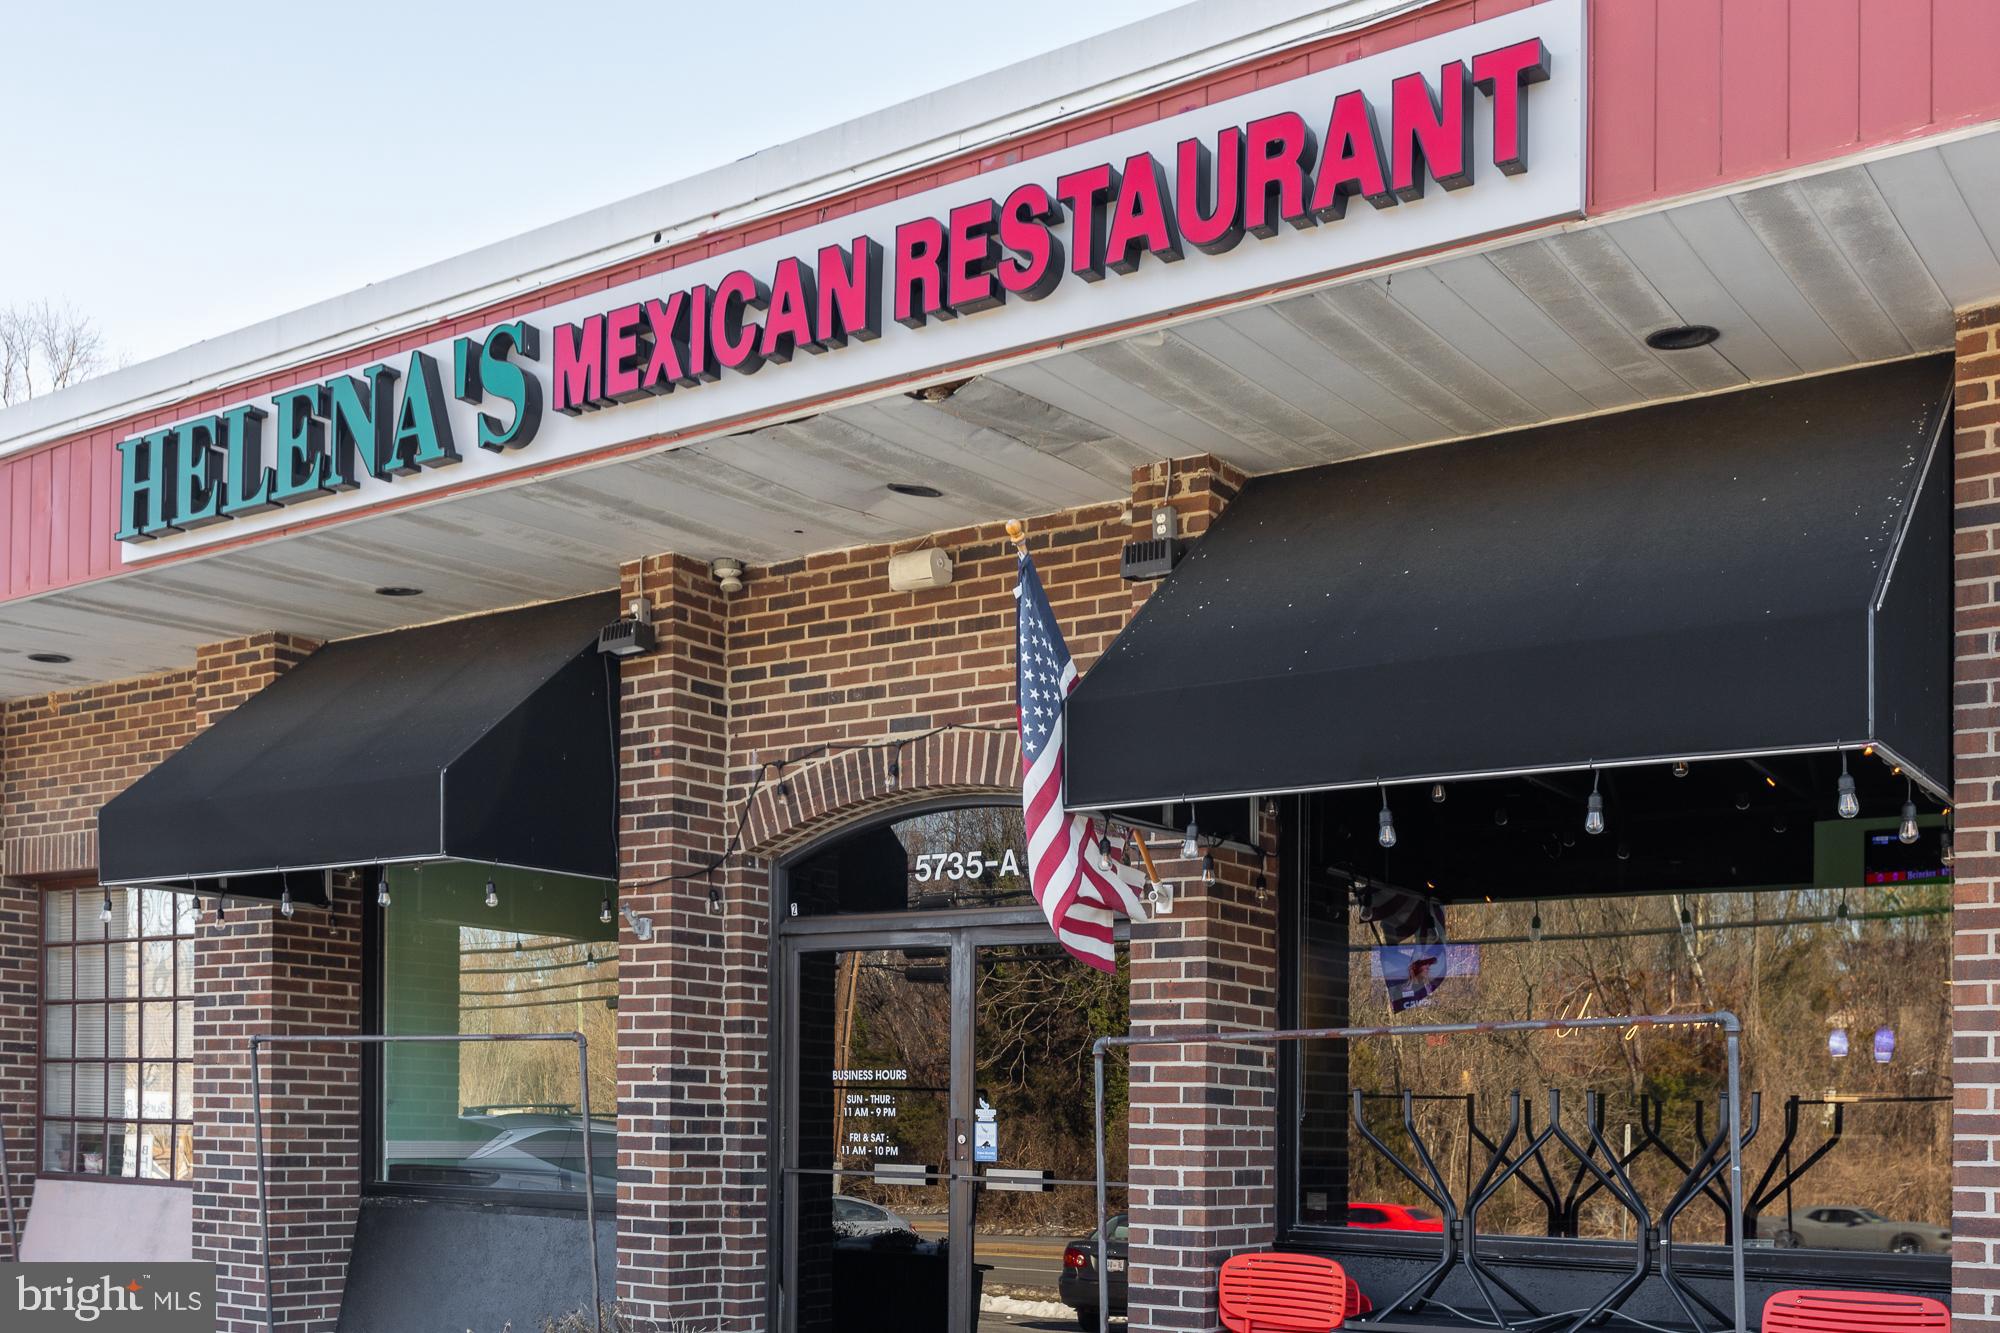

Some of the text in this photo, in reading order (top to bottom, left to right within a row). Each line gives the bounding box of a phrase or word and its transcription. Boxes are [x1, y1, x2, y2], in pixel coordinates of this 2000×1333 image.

[115, 37, 1551, 543] HELENA'S MEXICAN RESTAURANT
[914, 848, 1020, 882] 5735-A
[832, 1069, 907, 1080] BUSINESS HOURS
[846, 1094, 863, 1104] SUN
[843, 1107, 852, 1117] 11
[854, 1107, 869, 1117] AM
[875, 1108, 882, 1117] 9
[883, 1108, 896, 1117] PM
[849, 1132, 861, 1142] FRI
[862, 1133, 869, 1142] &
[841, 1145, 850, 1155] 11
[852, 1145, 866, 1155] AM
[874, 1146, 884, 1156] 10
[885, 1146, 899, 1156] PM
